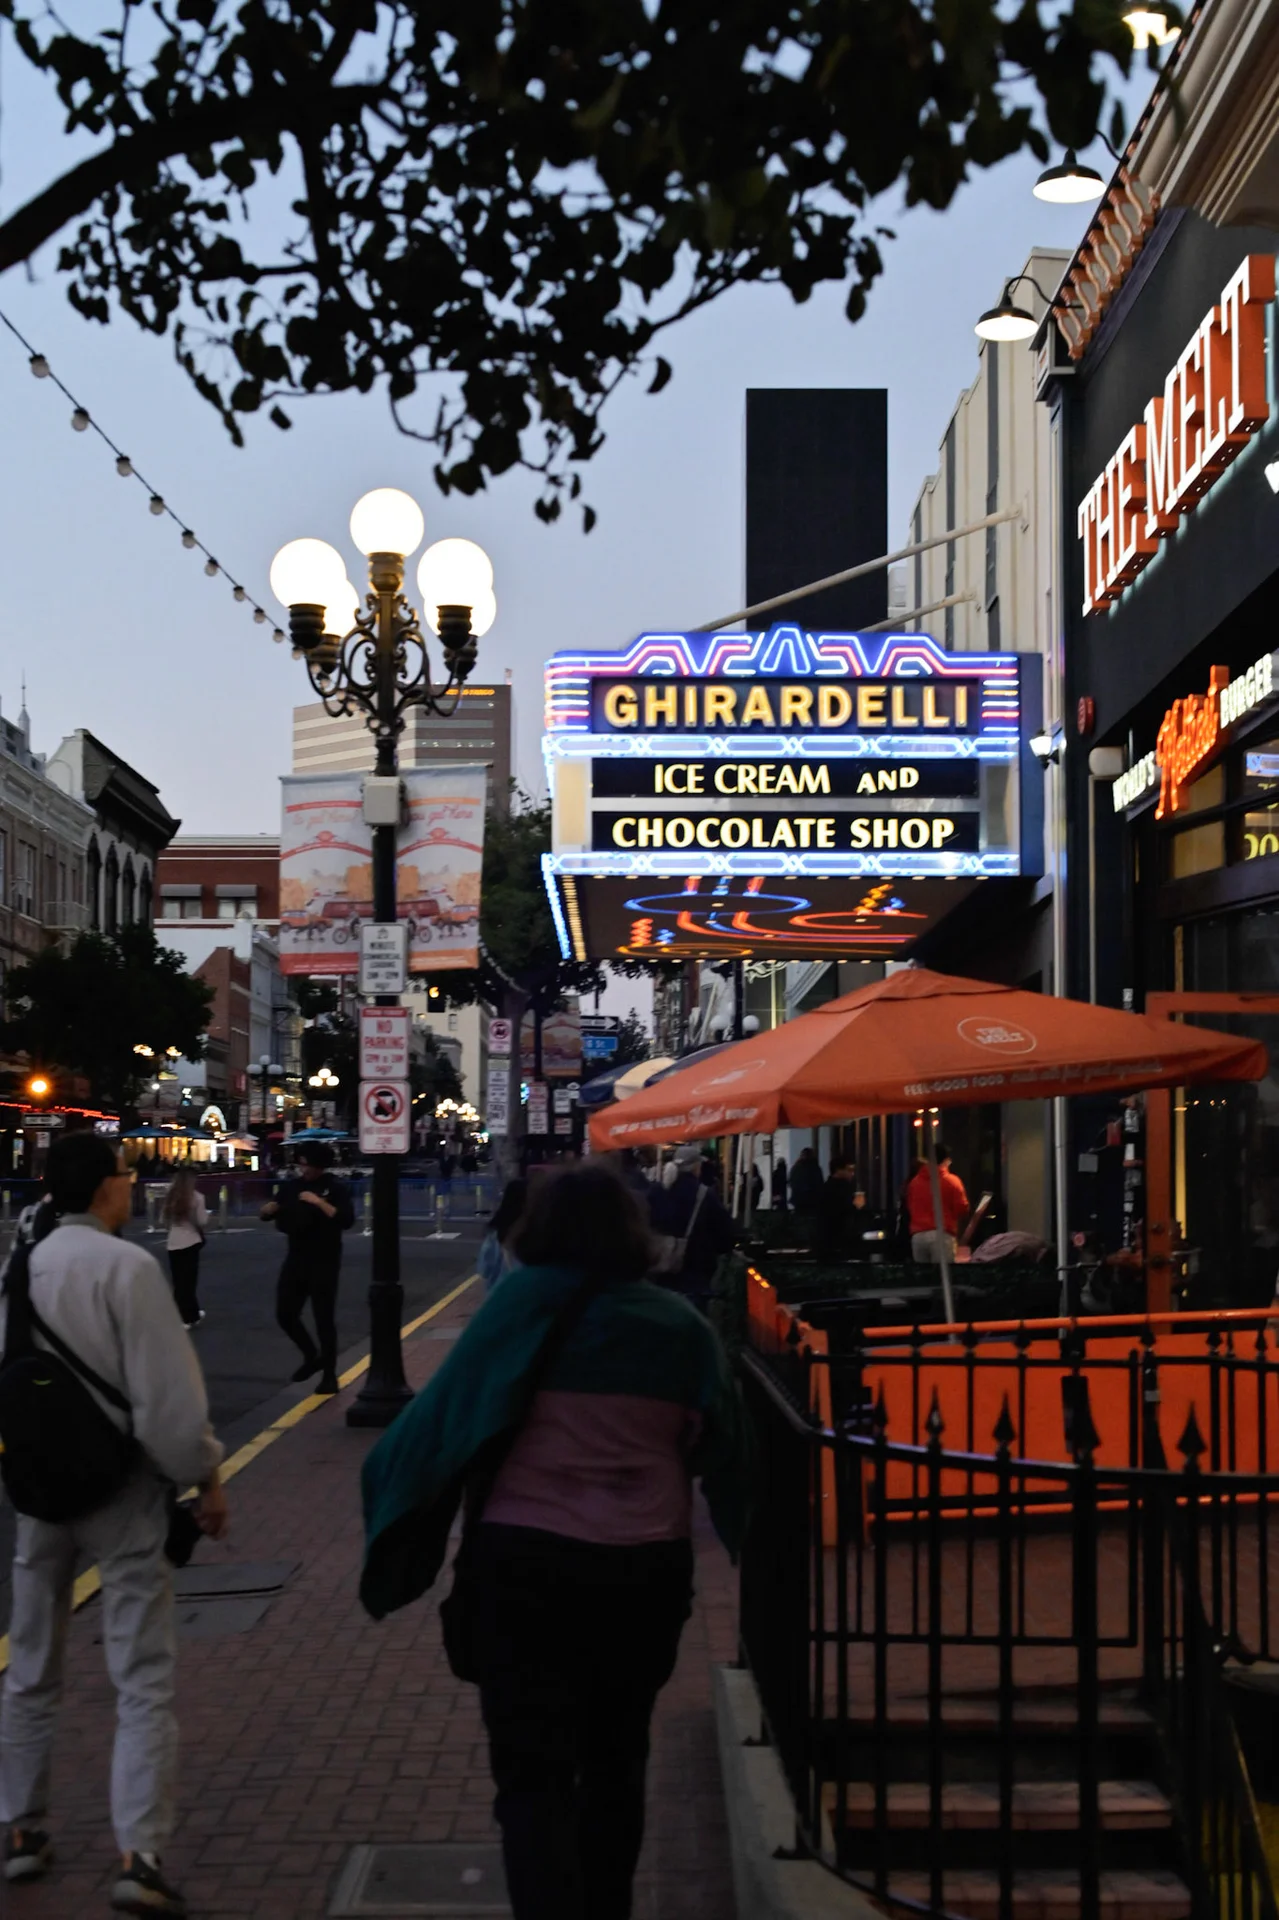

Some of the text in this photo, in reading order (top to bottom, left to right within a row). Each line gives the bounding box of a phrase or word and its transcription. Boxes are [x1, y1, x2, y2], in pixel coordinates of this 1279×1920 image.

[1078, 254, 1255, 618] THE MELT
[603, 685, 969, 729] GHIRARDELLI
[1113, 750, 1156, 813] WORLD'S
[1219, 652, 1274, 730] BURGER
[654, 763, 920, 794] ICE CREAM AND
[611, 816, 955, 849] CHOCOLATE SHOP
[364, 1036, 405, 1050] PARKING
[377, 1020, 393, 1034] NO
[972, 1074, 1005, 1088] FOOD
